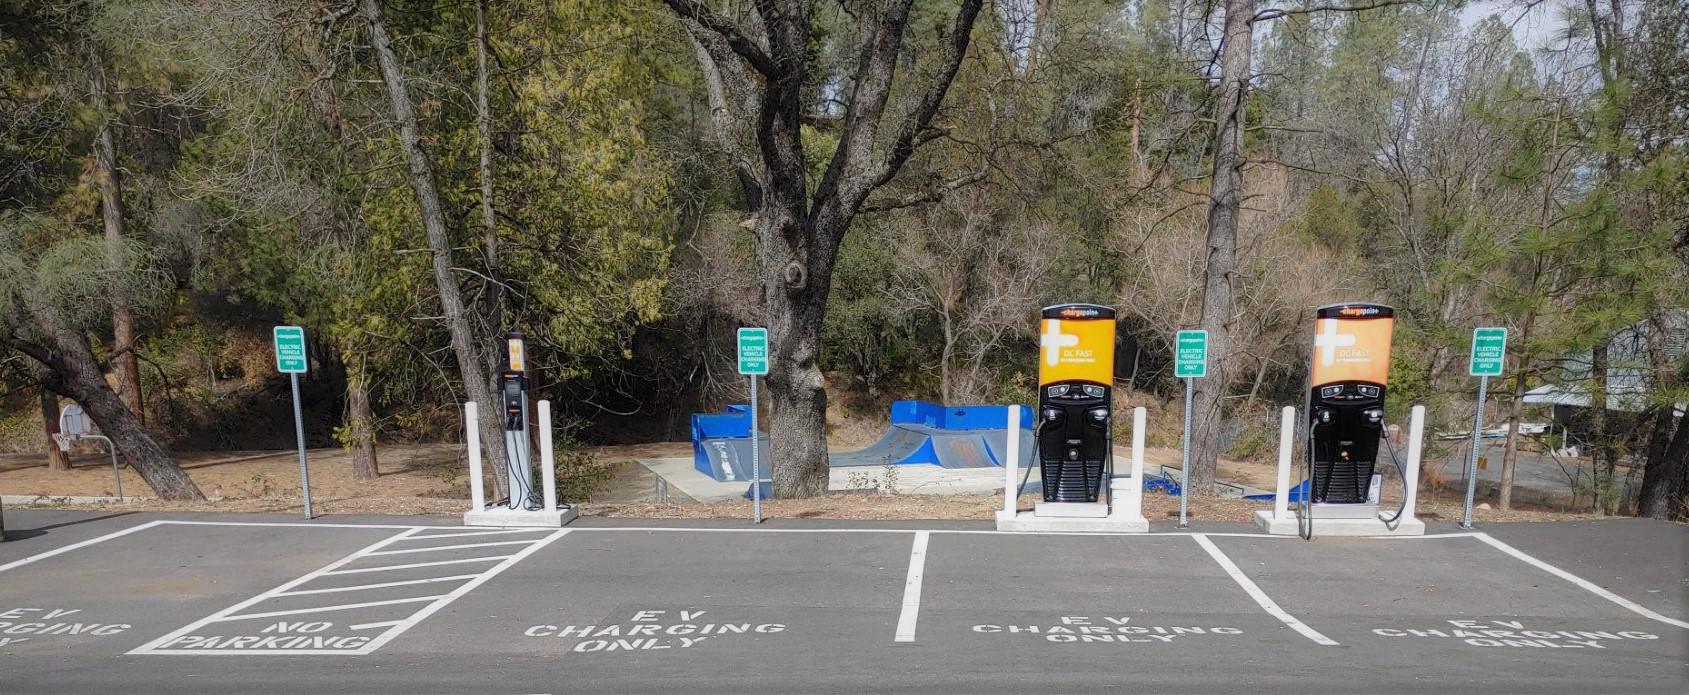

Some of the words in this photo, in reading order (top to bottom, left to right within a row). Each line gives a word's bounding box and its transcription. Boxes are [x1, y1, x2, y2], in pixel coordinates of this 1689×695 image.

[260, 621, 334, 633] NO
[524, 624, 786, 638] CHARGING
[972, 624, 1245, 635] CHARGING
[1046, 634, 1179, 643] ONLY
[1371, 628, 1660, 640] CHARGING
[158, 636, 370, 649] PARKING
[574, 637, 709, 652] ONLY
